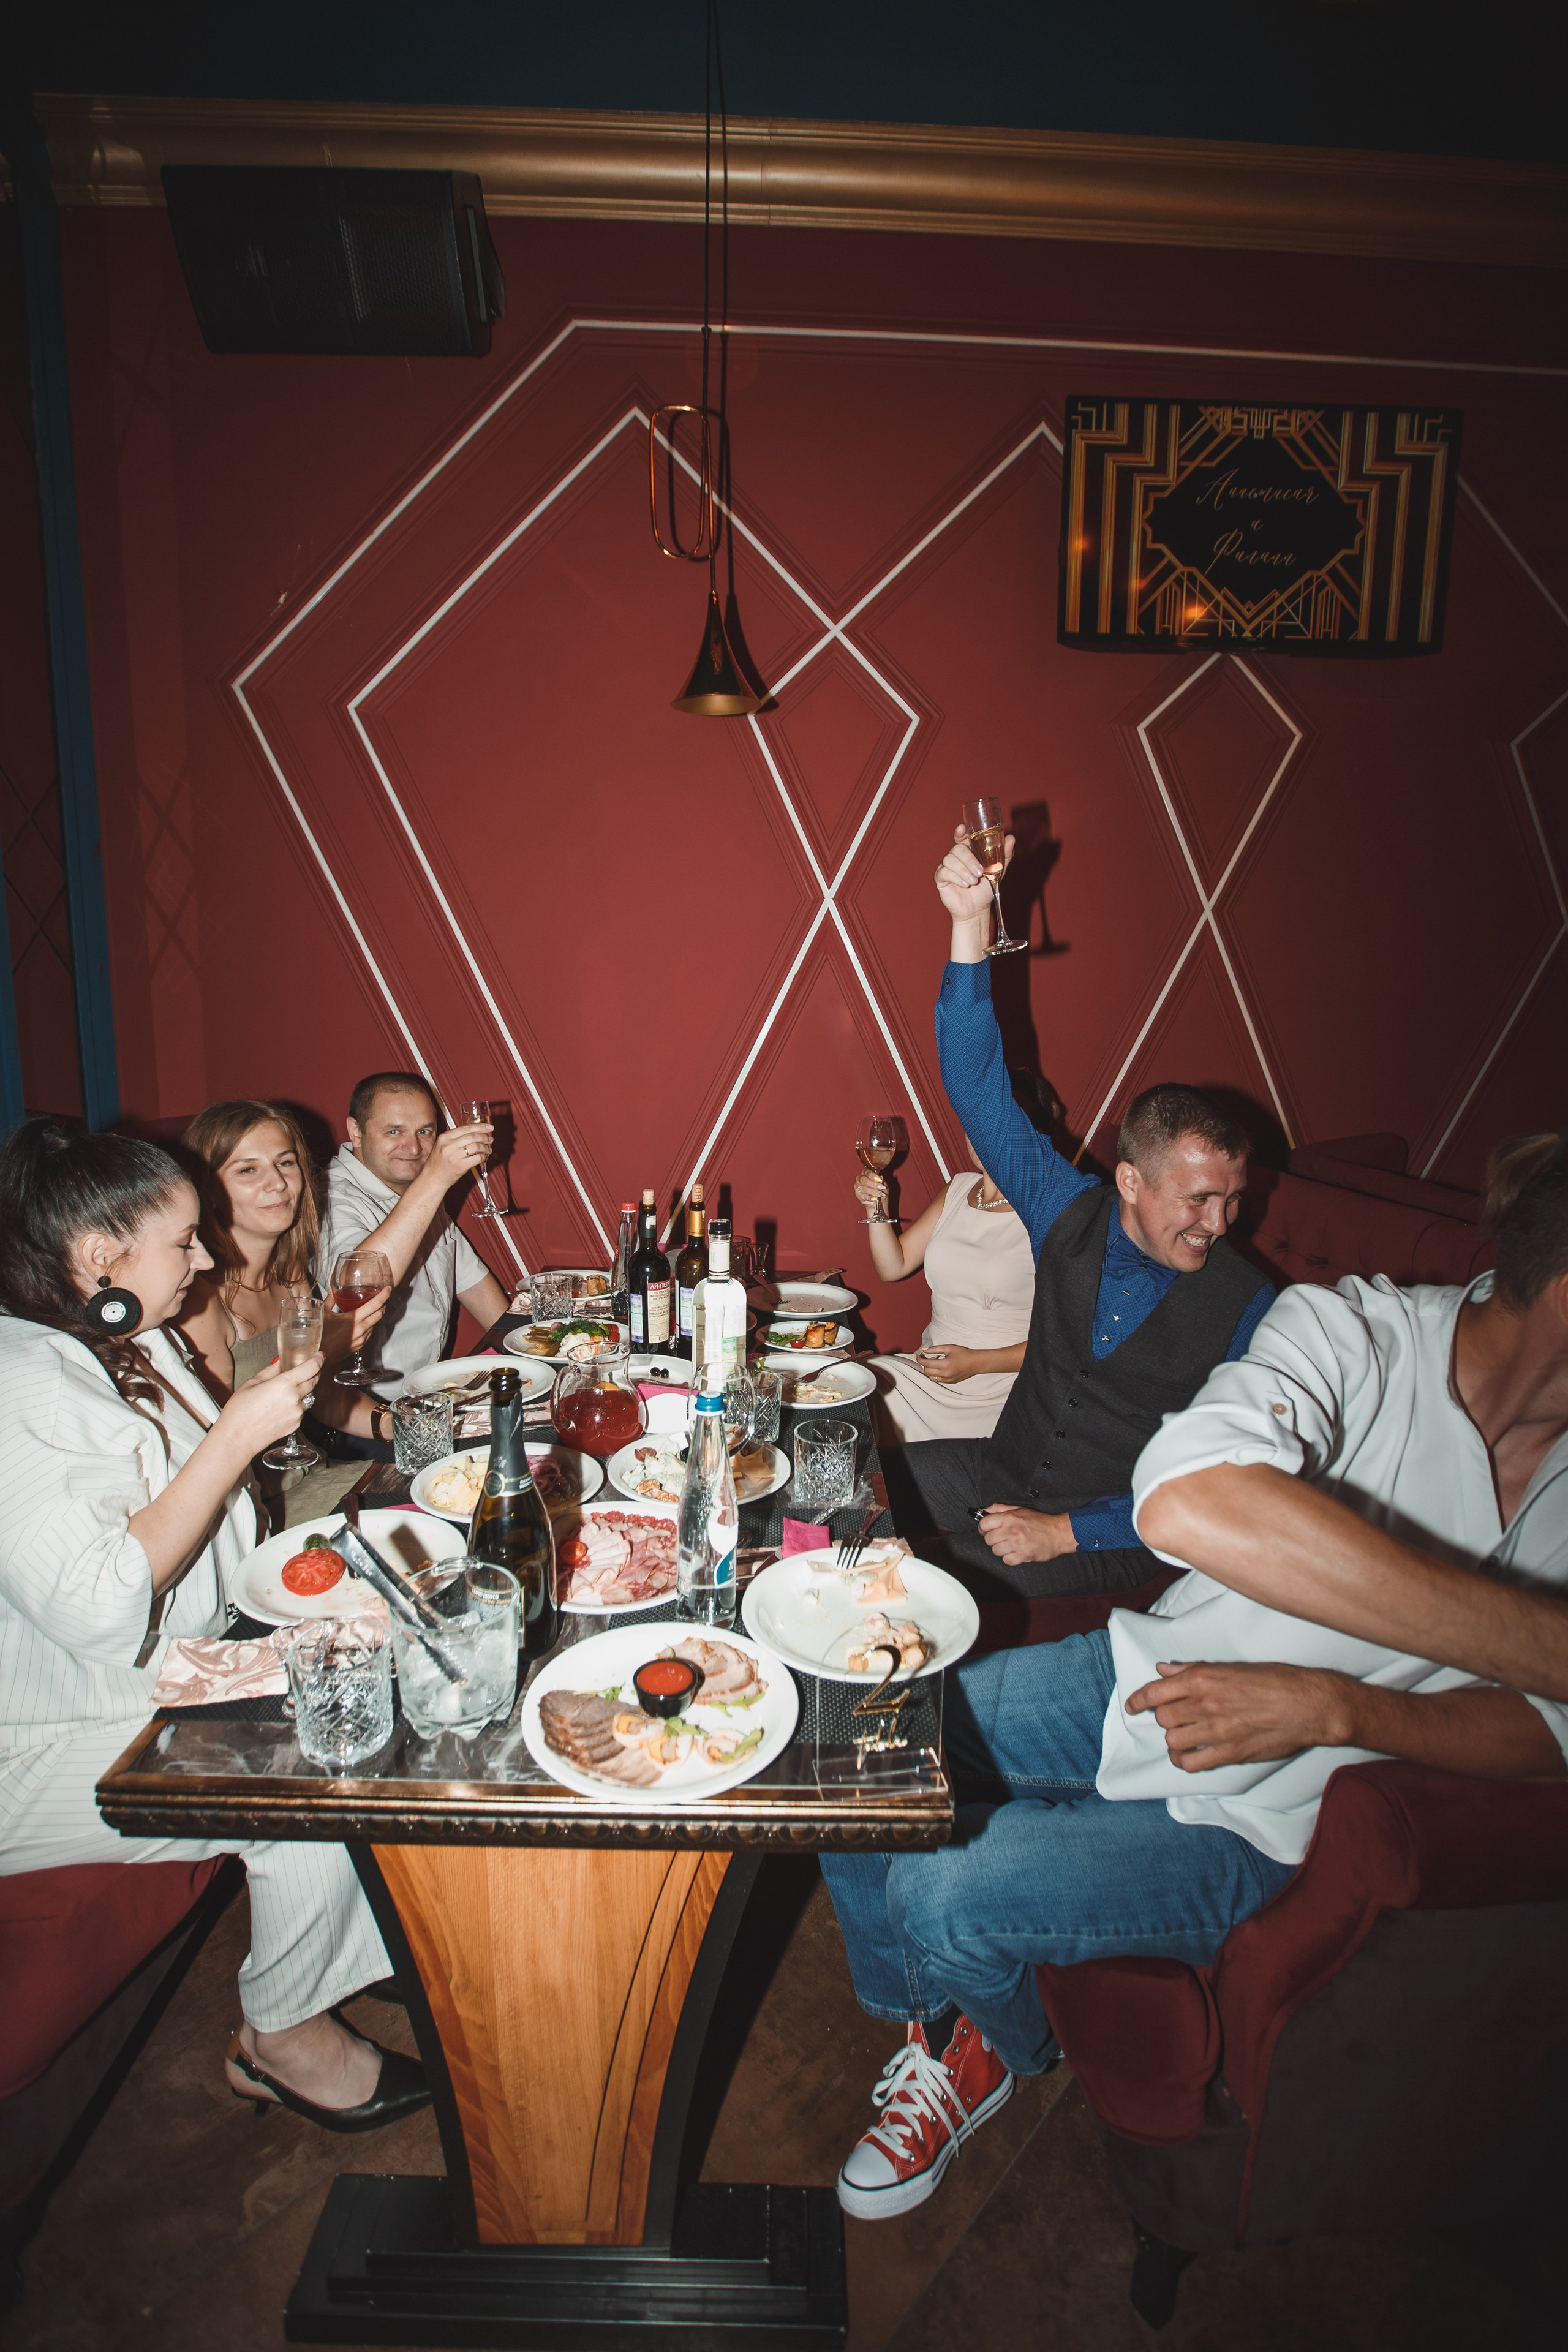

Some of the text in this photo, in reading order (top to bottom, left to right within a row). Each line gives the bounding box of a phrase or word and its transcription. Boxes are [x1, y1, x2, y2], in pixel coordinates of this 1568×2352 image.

[1250, 519, 1264, 532] и
[1204, 527, 1297, 575] Филипп
[852, 1644, 910, 1716] 2
